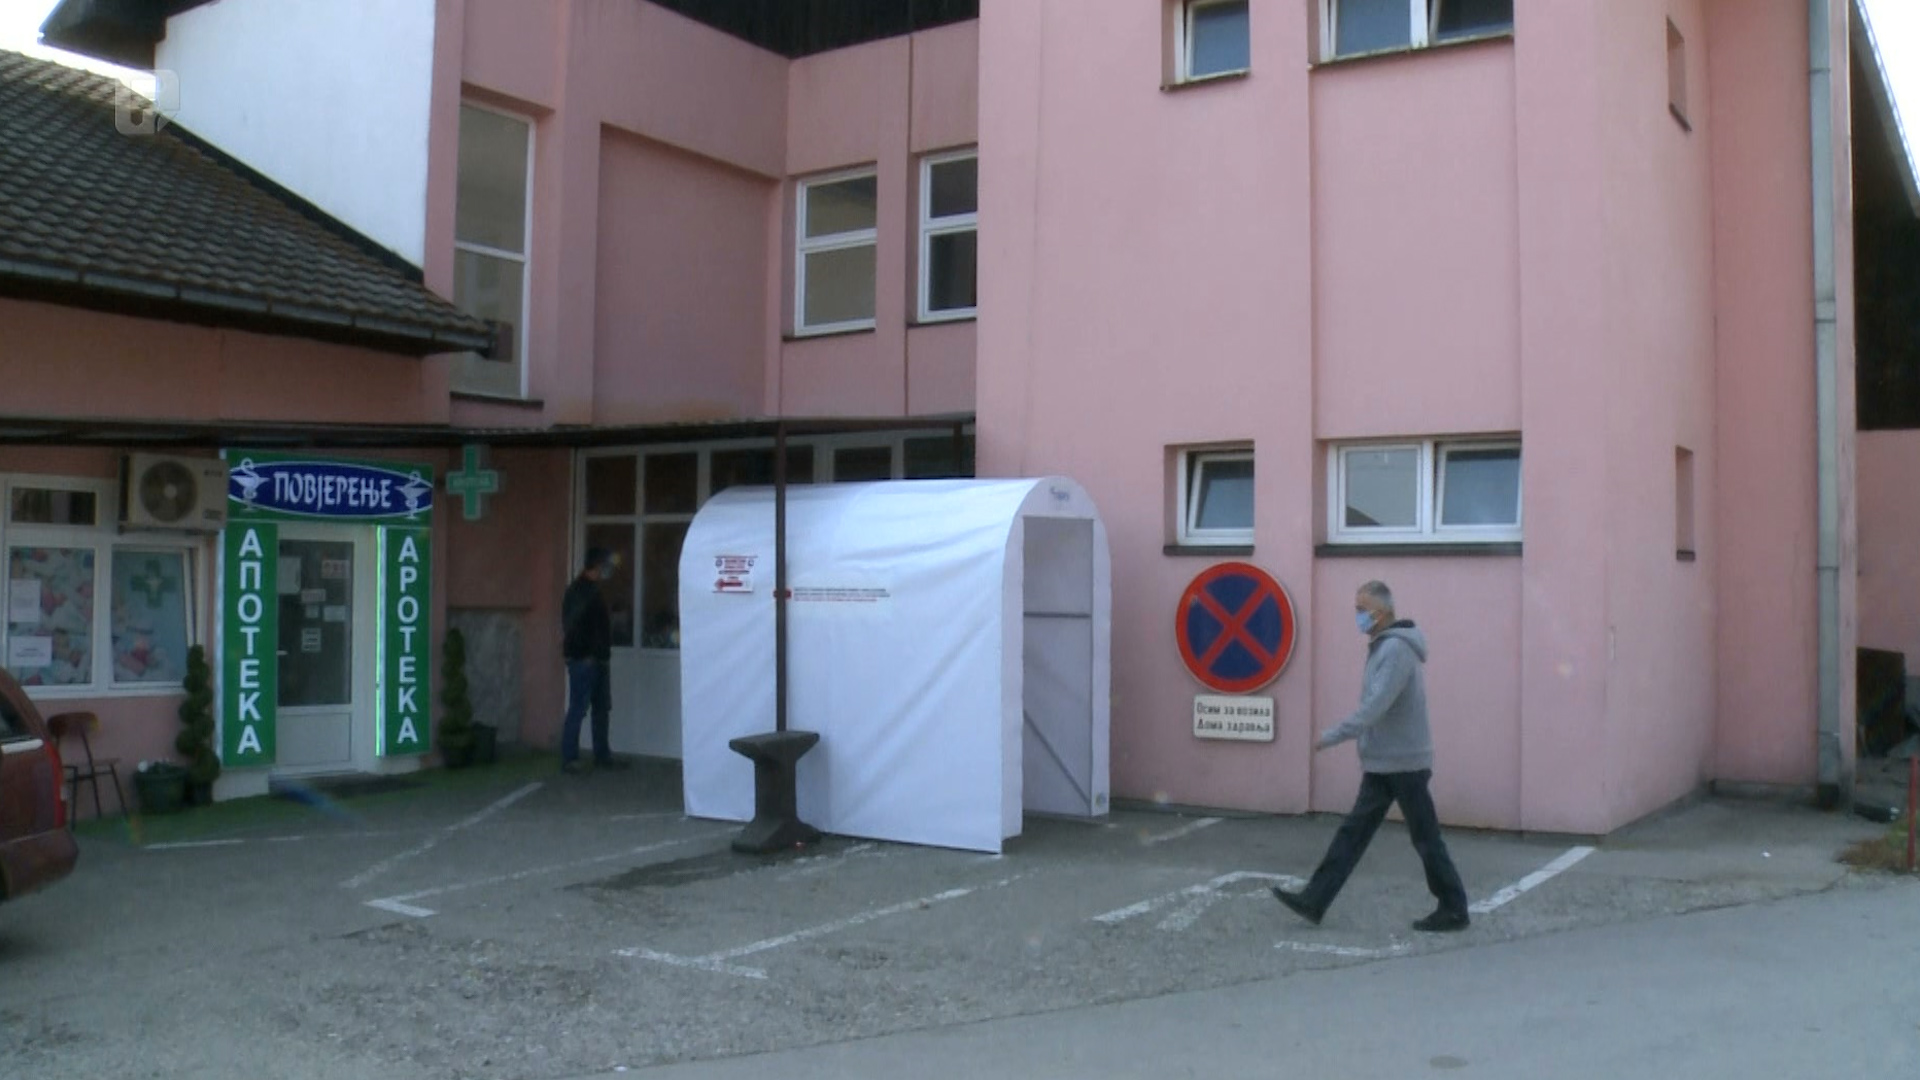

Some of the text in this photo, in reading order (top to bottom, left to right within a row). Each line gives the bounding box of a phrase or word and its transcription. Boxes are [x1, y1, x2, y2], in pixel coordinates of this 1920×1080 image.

[273, 470, 393, 512] ПОВЈЕРЕЊЕ
[237, 528, 263, 754] АПОТЕКА
[397, 535, 419, 743] APOTEKA
[1197, 702, 1220, 714] Осим
[1224, 706, 1235, 715] за
[1197, 718, 1223, 730] Дома
